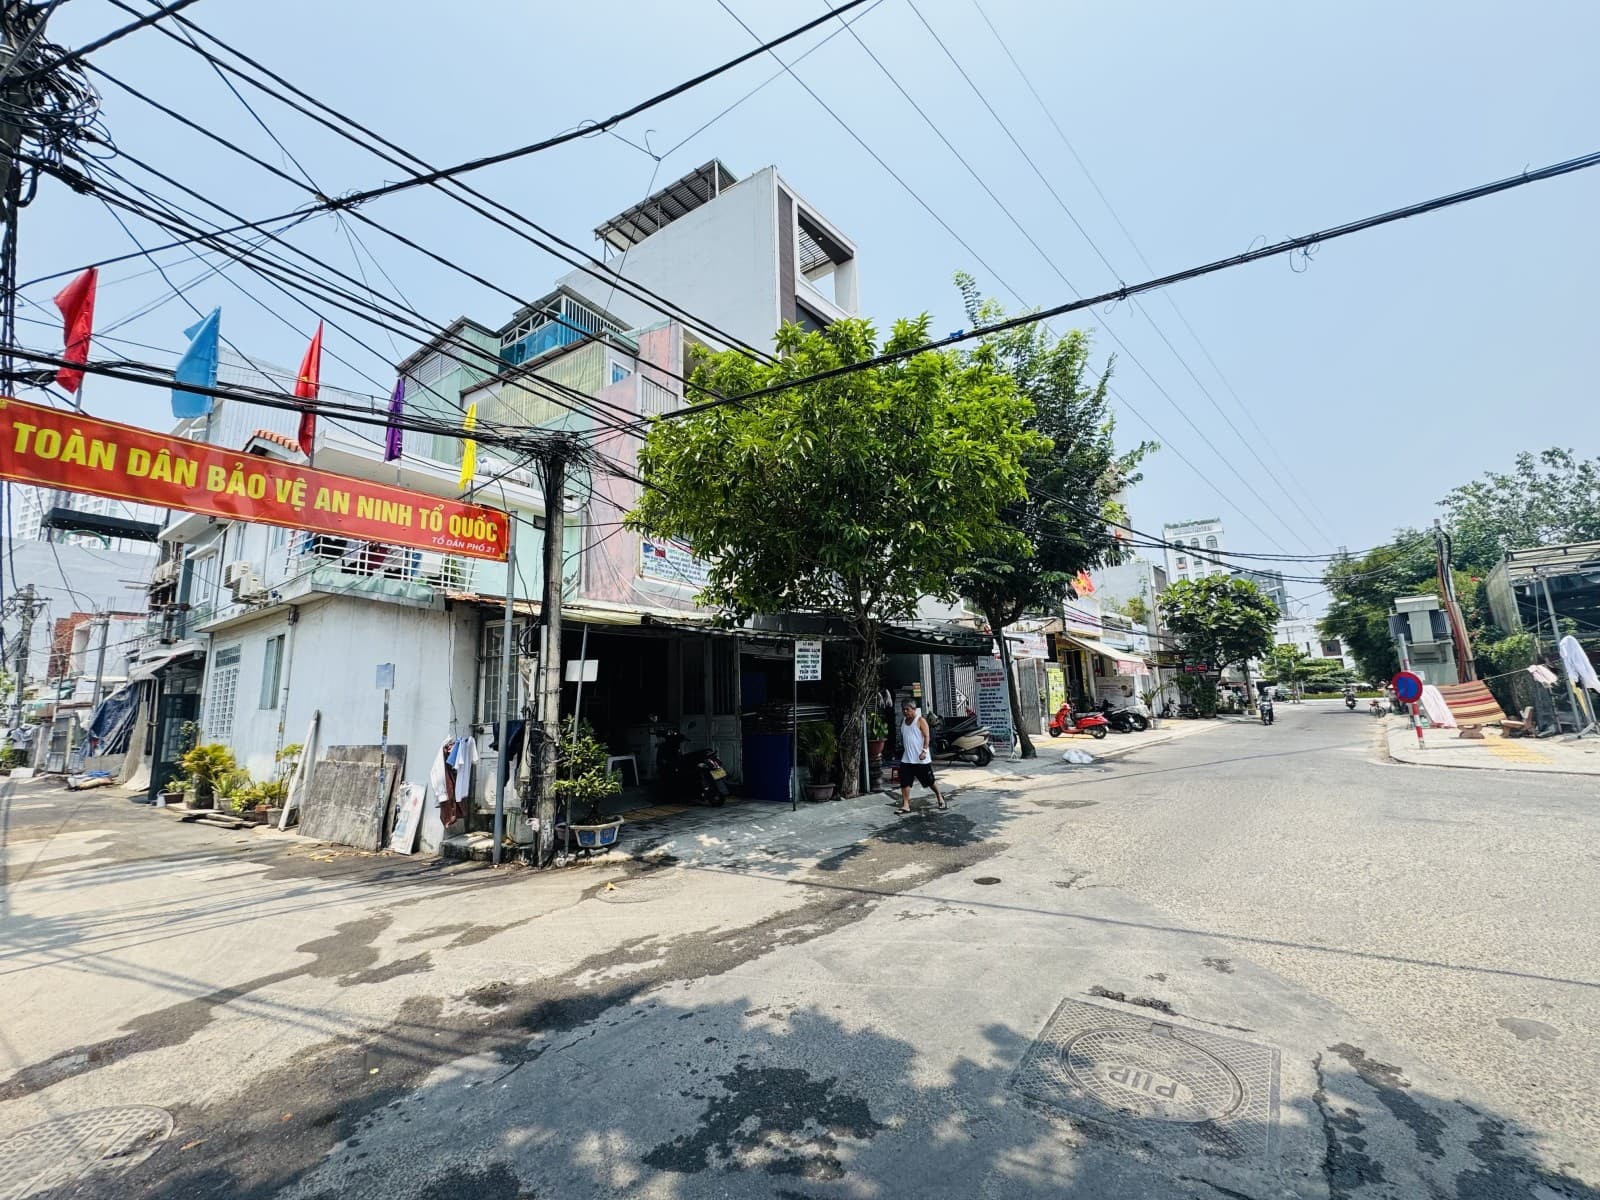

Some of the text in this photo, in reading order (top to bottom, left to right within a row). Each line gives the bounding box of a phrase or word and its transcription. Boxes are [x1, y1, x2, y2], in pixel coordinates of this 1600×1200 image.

[12, 421, 497, 542] TOÀN DÂN BẢO VỆ AN NINH TỔ QUỐC
